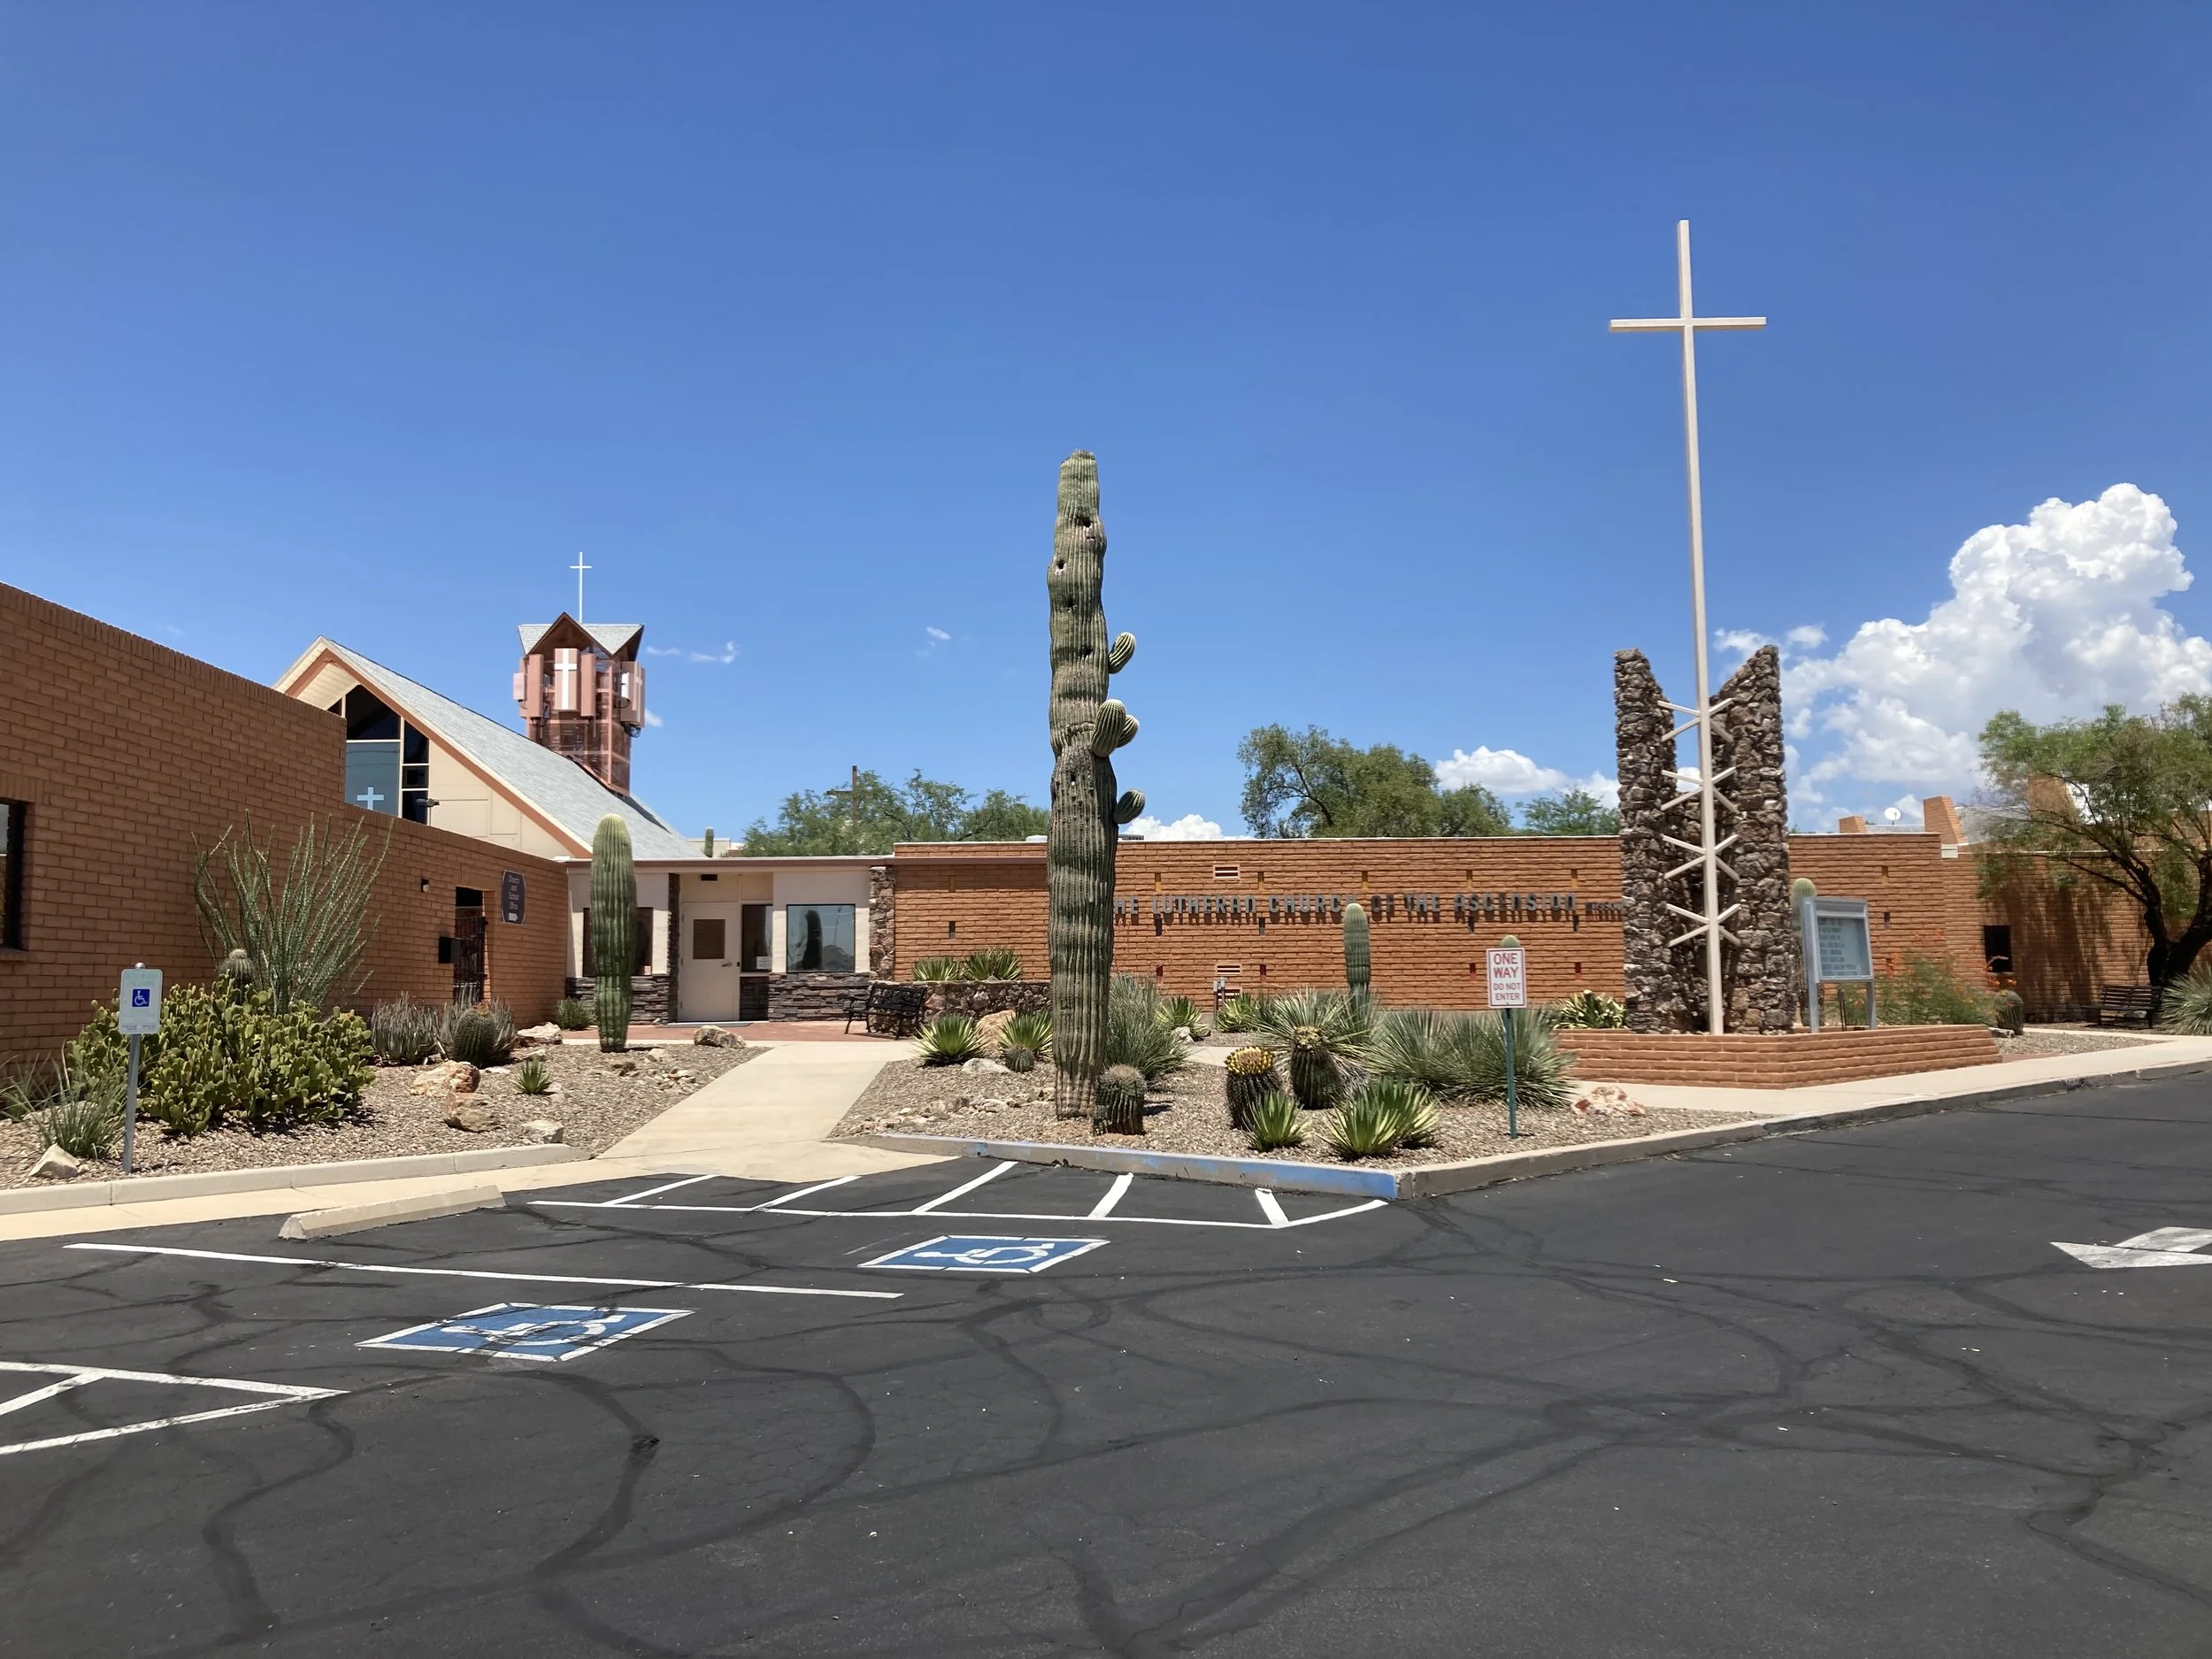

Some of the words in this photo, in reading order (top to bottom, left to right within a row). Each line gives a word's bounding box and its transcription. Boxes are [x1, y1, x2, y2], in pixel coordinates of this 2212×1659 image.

[1114, 895, 1139, 914] HE
[1153, 895, 1256, 913] LUTHERAN
[1371, 894, 1394, 912] OF
[1404, 894, 1440, 912] THE
[1455, 894, 1577, 912] ASCENSION
[1494, 953, 1518, 964] ONE
[1493, 967, 1519, 979] WAY
